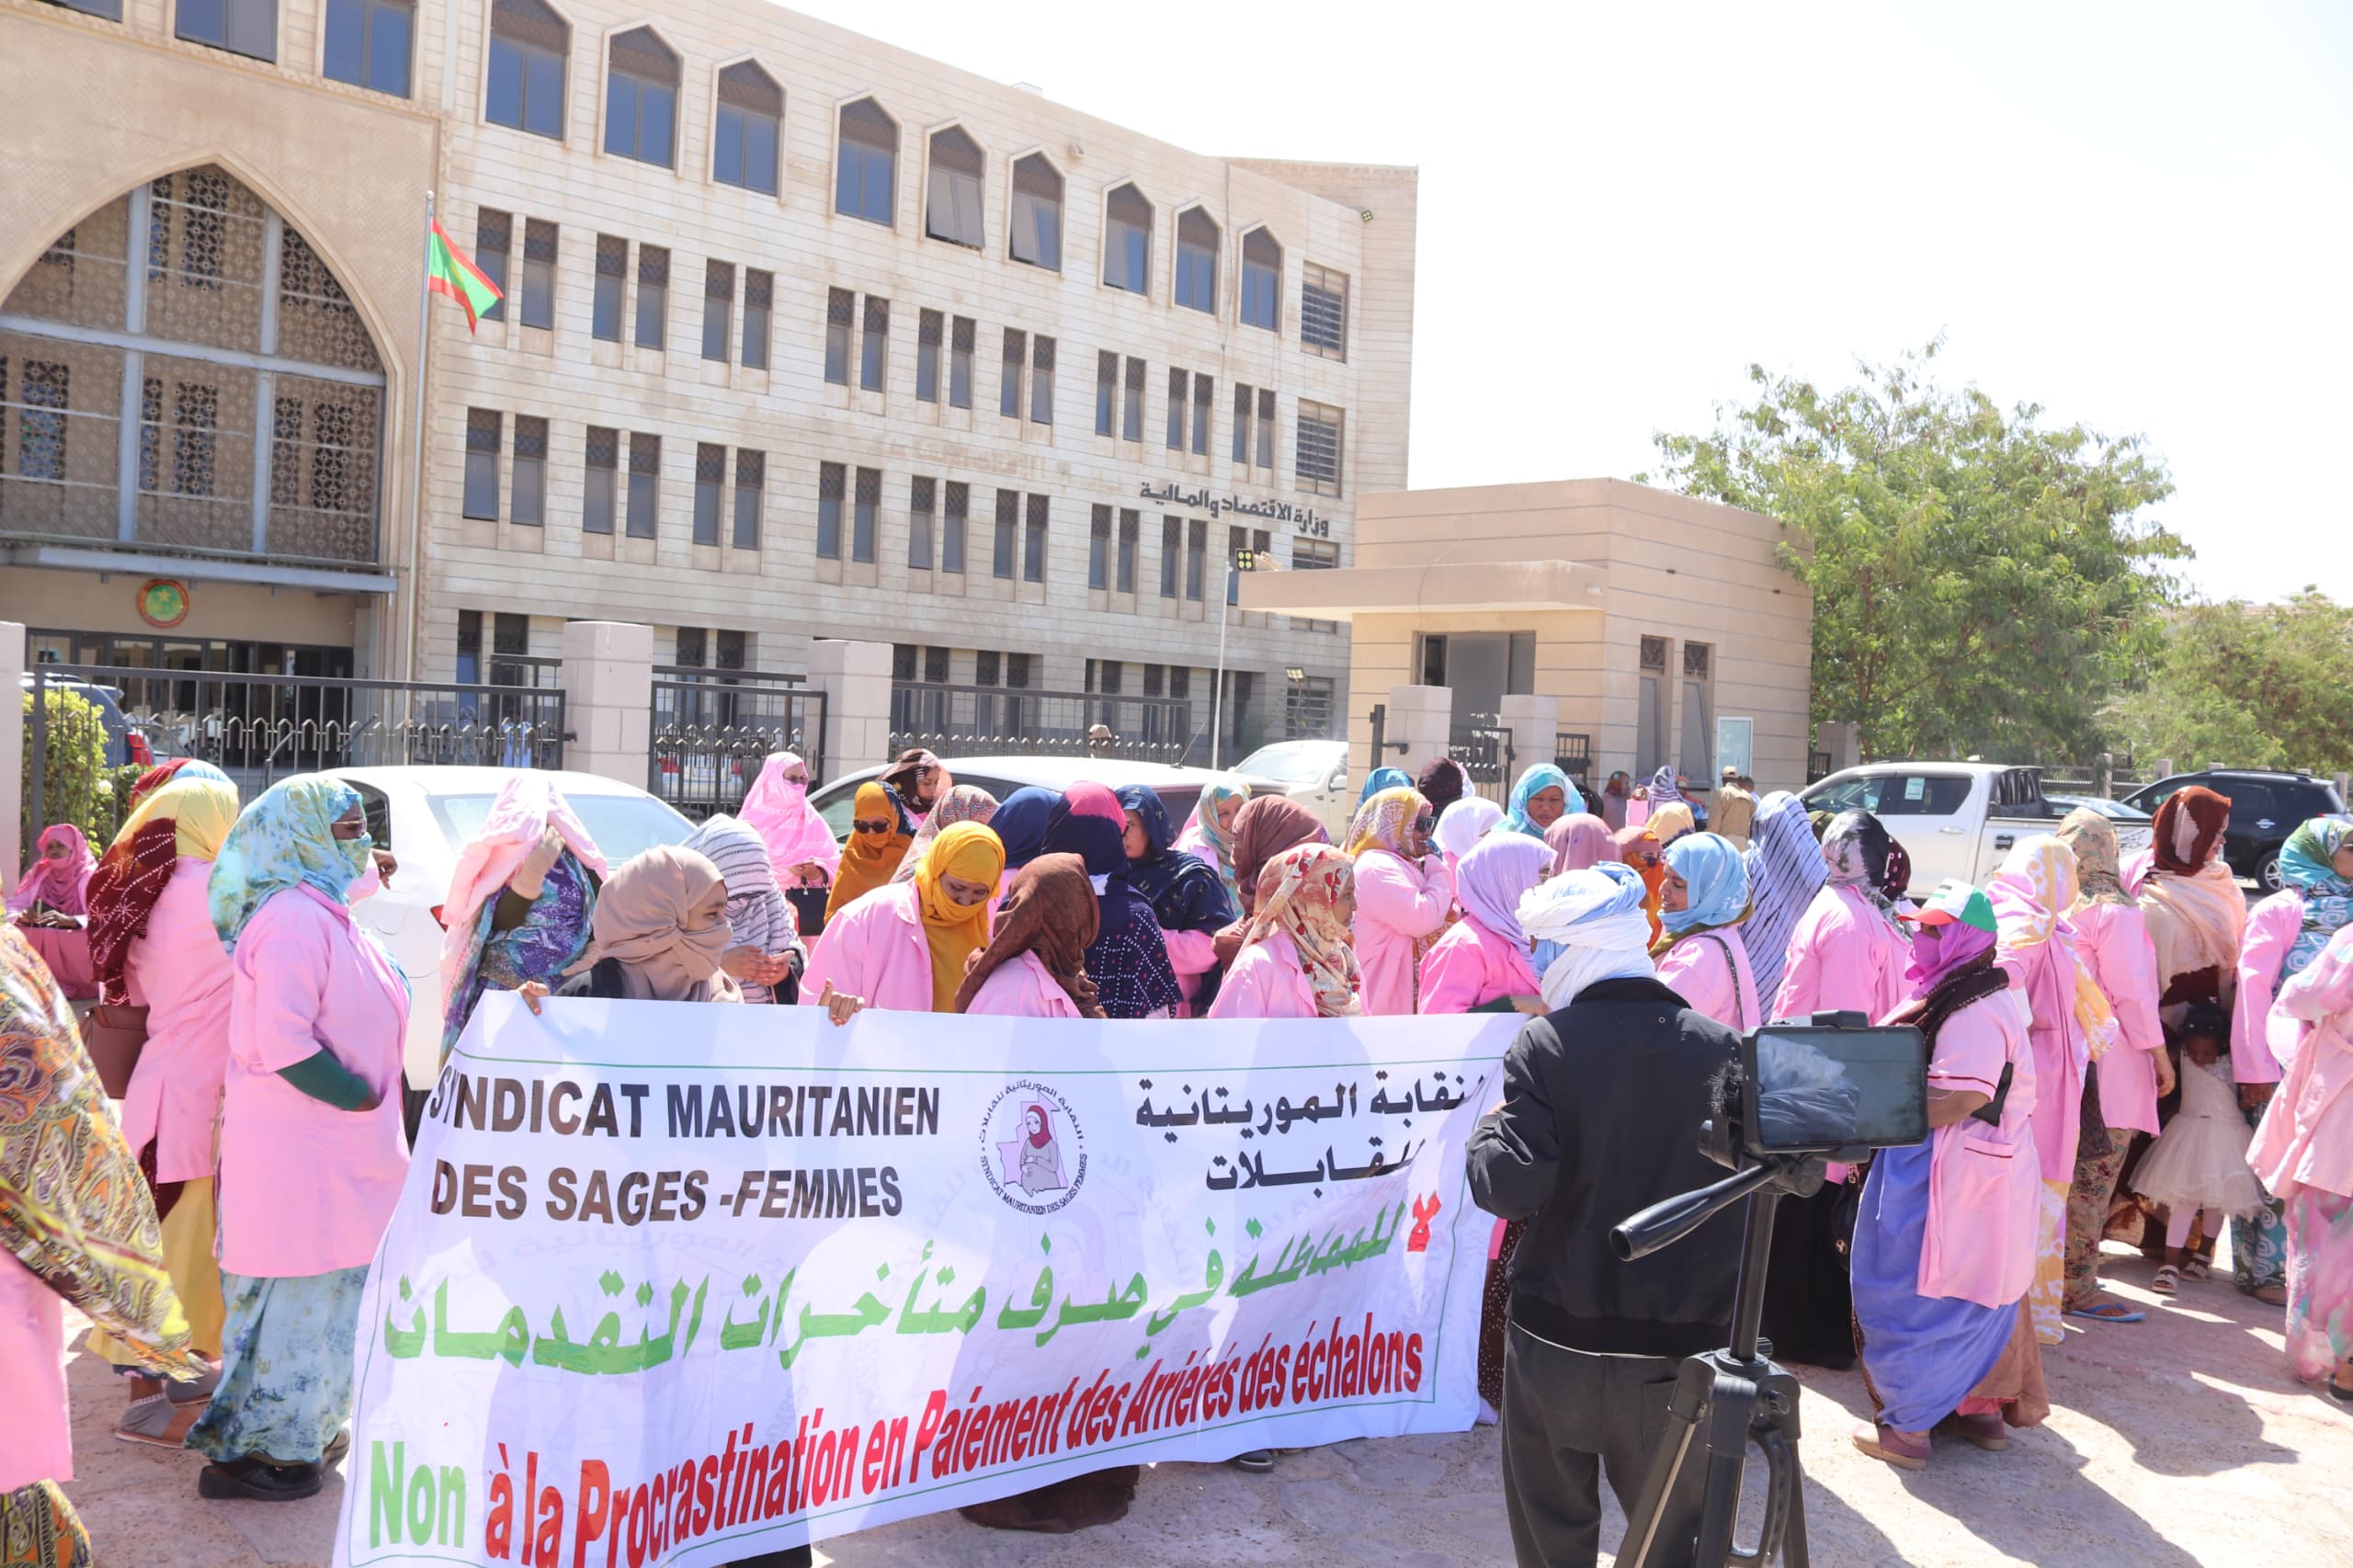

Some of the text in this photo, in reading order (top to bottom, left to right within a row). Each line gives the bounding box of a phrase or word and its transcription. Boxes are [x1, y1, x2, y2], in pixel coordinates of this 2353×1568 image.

[1140, 481, 1329, 538] وزارة الاقتصاد والمالية
[429, 1064, 939, 1138] SYNDICAT MAURITANIEN
[1135, 1077, 1358, 1144] الموريتانية
[430, 1158, 528, 1221] DES
[545, 1166, 709, 1227] SAGES
[980, 1155, 1004, 1197] SYNDICAT
[1002, 1192, 1046, 1215] MAURITANIEN
[1047, 1200, 1060, 1213] DES
[1059, 1186, 1077, 1207] SAGES
[1406, 1190, 1443, 1253] لا
[720, 1239, 987, 1370] متأخرات
[996, 1232, 1148, 1348] صرف
[1135, 1215, 1225, 1360] في
[369, 1312, 1423, 1568] Non à la Procrastination en Paiement des Arriérés des échalons
